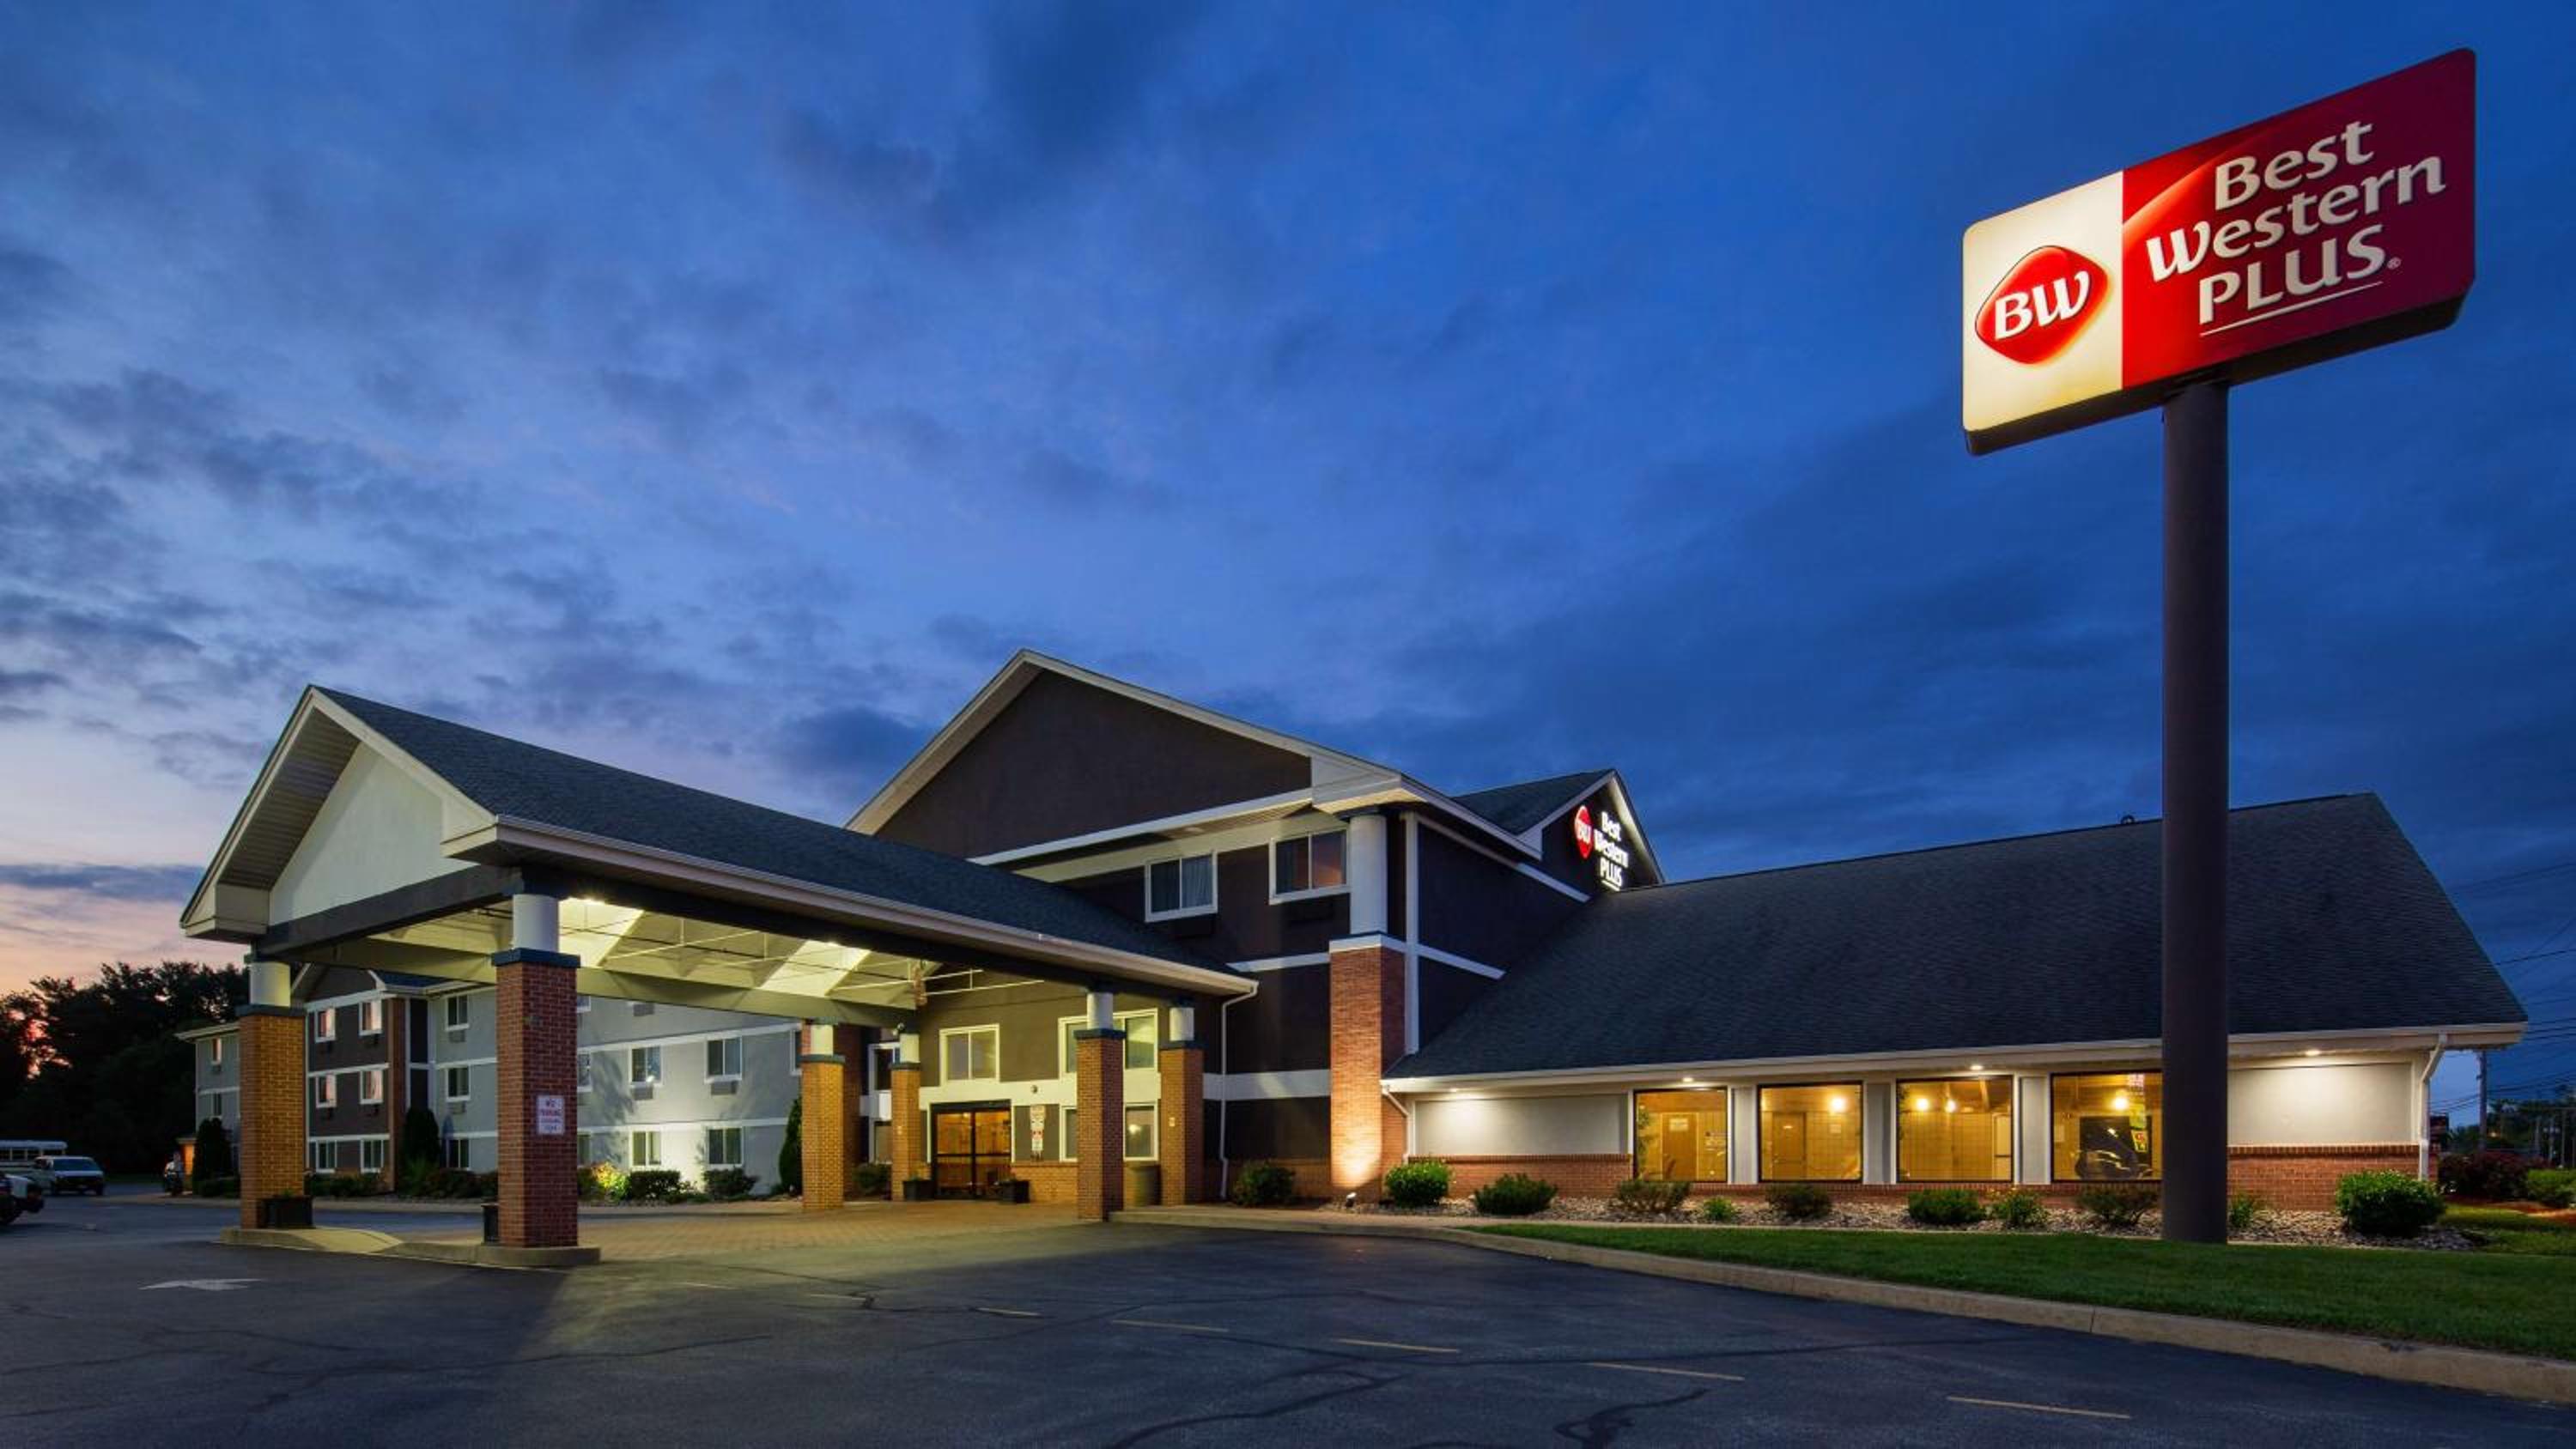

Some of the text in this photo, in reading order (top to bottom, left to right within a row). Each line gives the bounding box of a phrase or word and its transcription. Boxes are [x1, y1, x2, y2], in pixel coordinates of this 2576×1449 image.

[2215, 120, 2372, 211] Best
[2147, 155, 2446, 282] Western
[1994, 270, 2090, 341] BW
[2199, 225, 2387, 324] PLUS
[1600, 856, 1623, 888] PLUS
